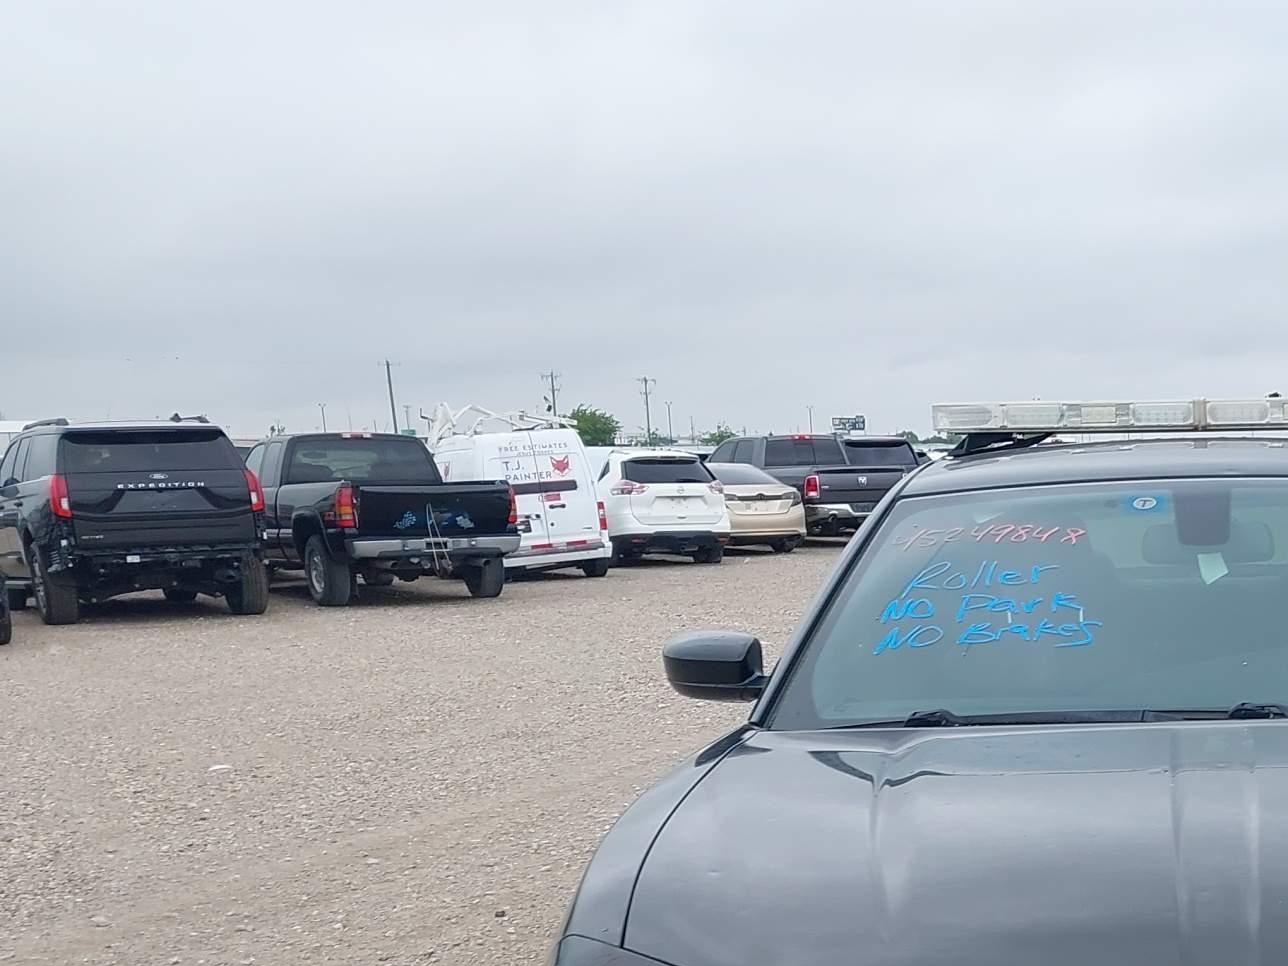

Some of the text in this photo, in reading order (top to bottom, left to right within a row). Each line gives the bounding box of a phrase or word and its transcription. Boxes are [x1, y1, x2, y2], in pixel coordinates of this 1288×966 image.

[522, 442, 568, 451] ESTIMATES
[117, 481, 205, 489] EXPEDITION
[505, 471, 552, 481] PAINTER
[894, 524, 1086, 550] 45249848
[900, 560, 1061, 599] Roller
[955, 592, 1084, 623] Park
